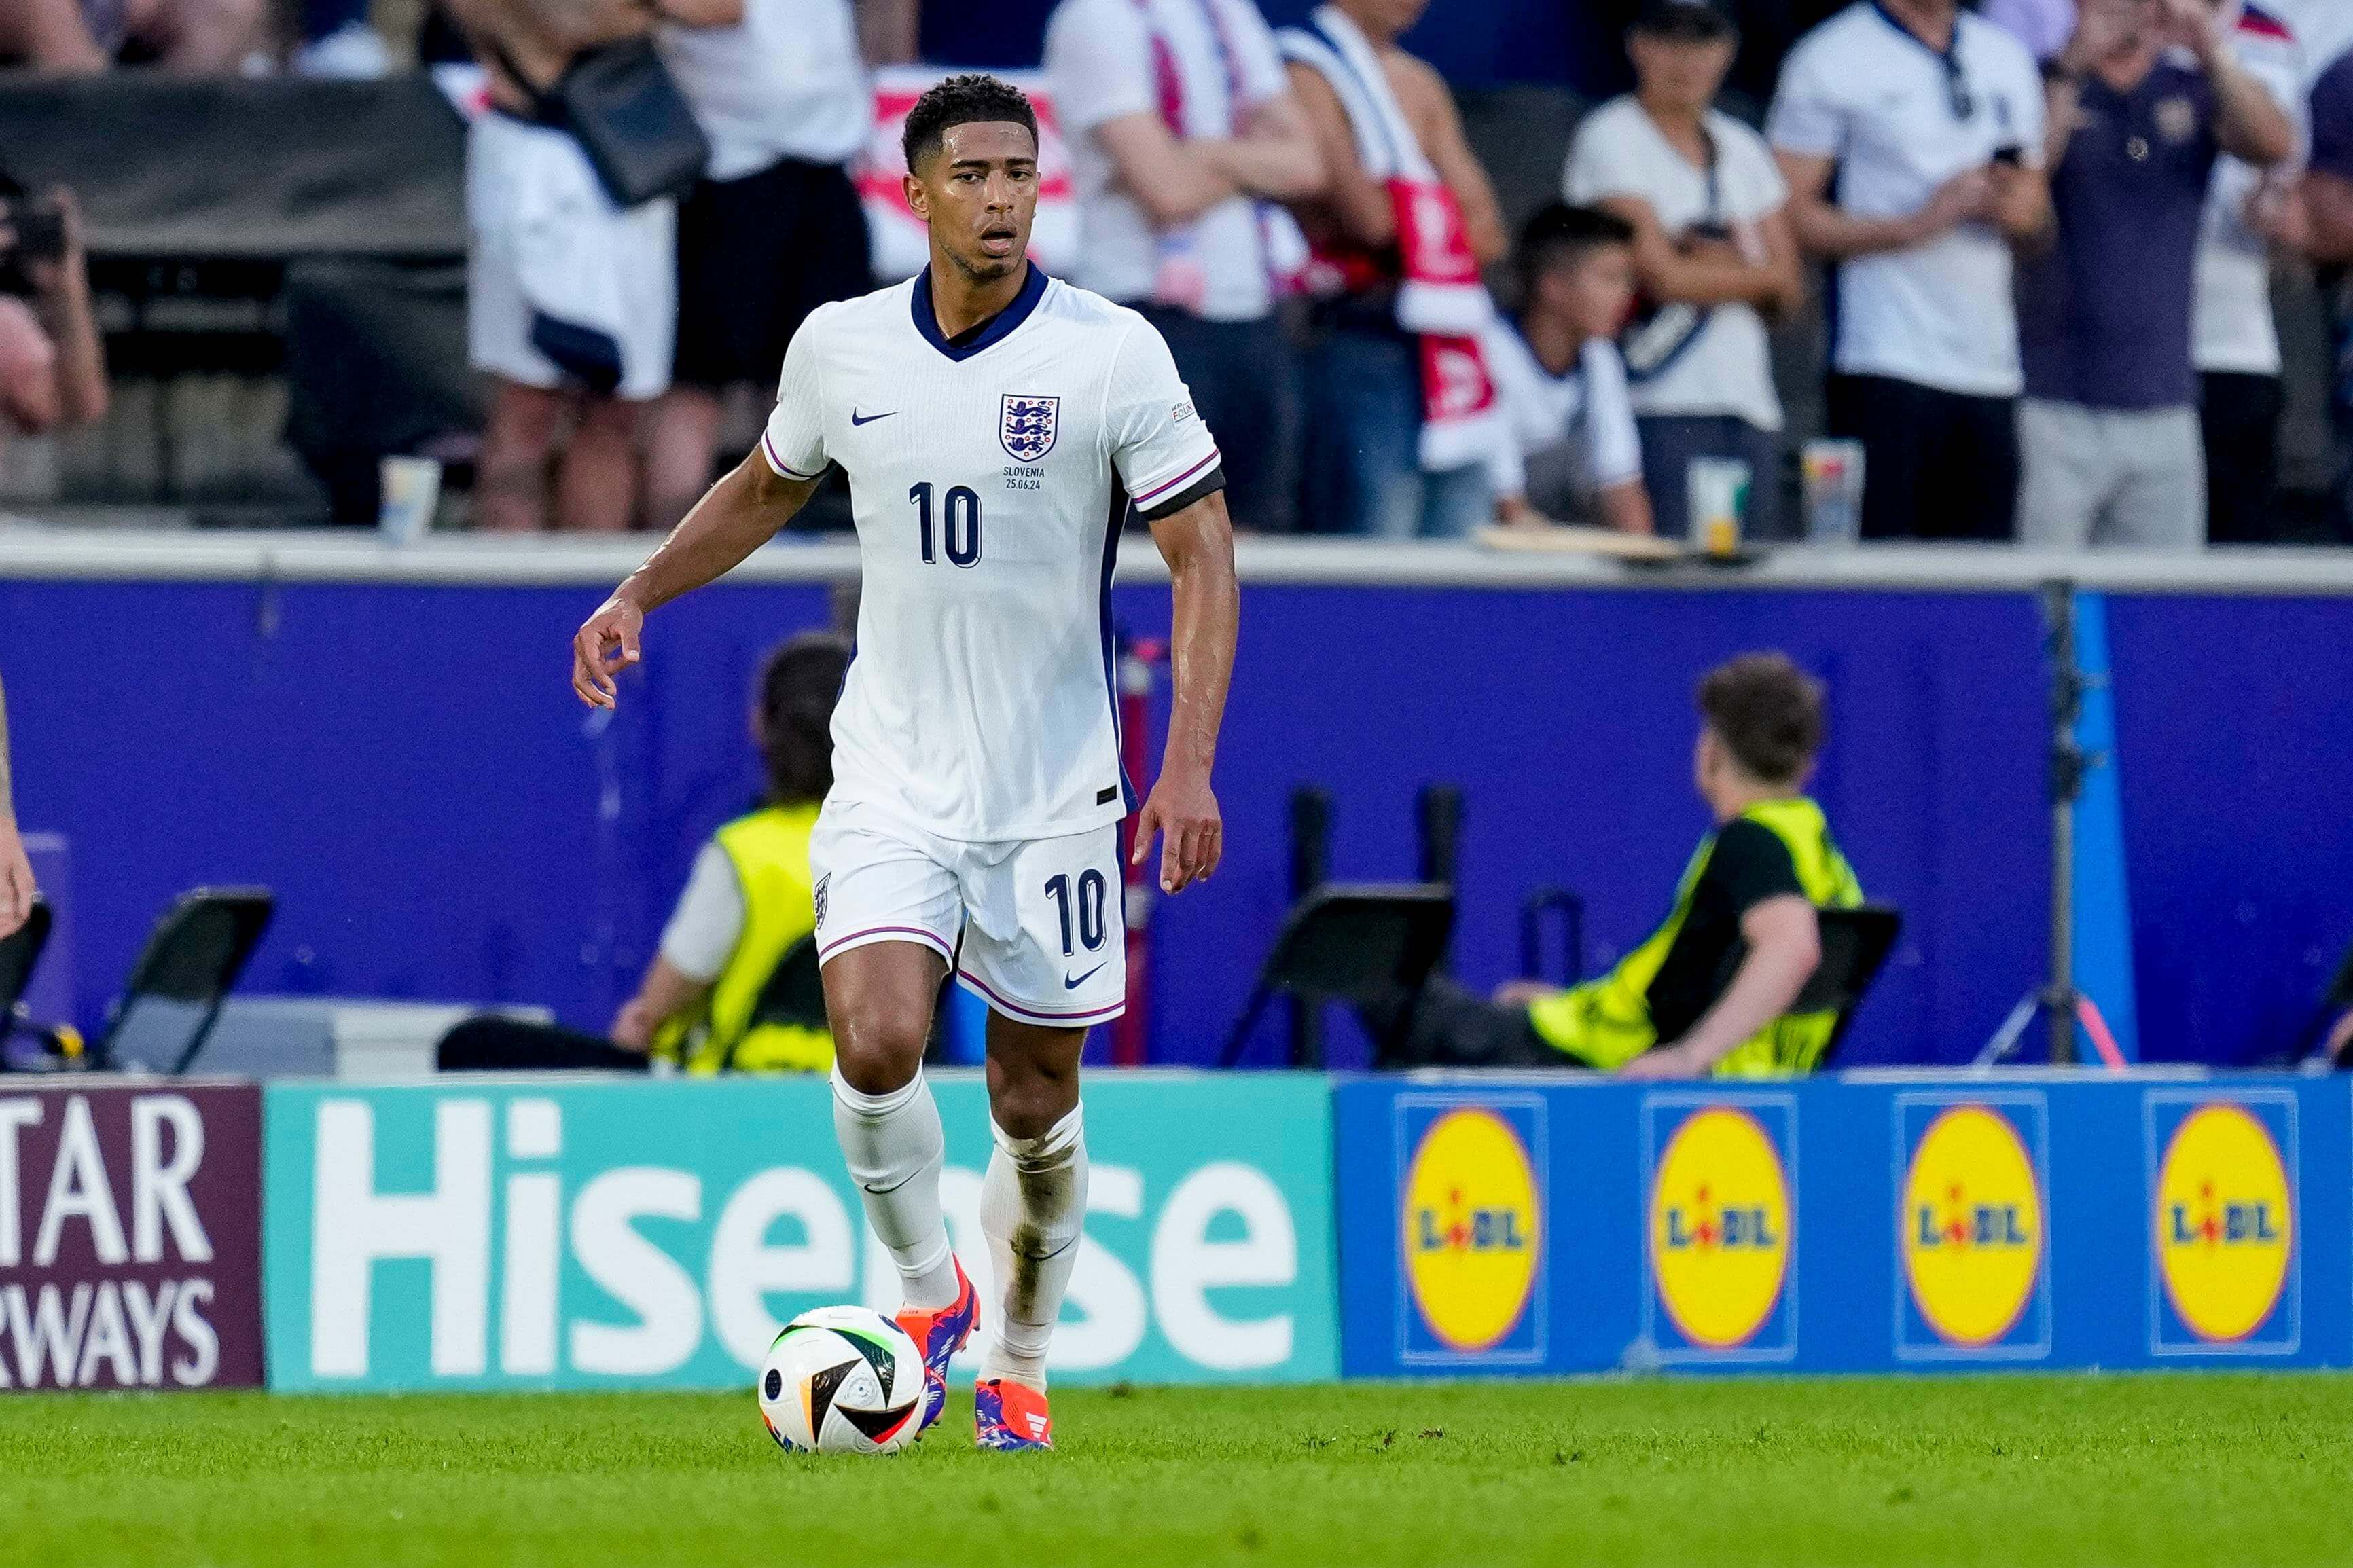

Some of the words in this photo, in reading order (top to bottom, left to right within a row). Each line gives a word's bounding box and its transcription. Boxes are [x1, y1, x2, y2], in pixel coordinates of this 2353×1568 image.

[1003, 467, 1045, 477] SLOVENIA
[1006, 479, 1041, 490] 25.06.24
[910, 481, 982, 569] 10
[1045, 869, 1107, 957] 10
[0, 1094, 214, 1267] TAR
